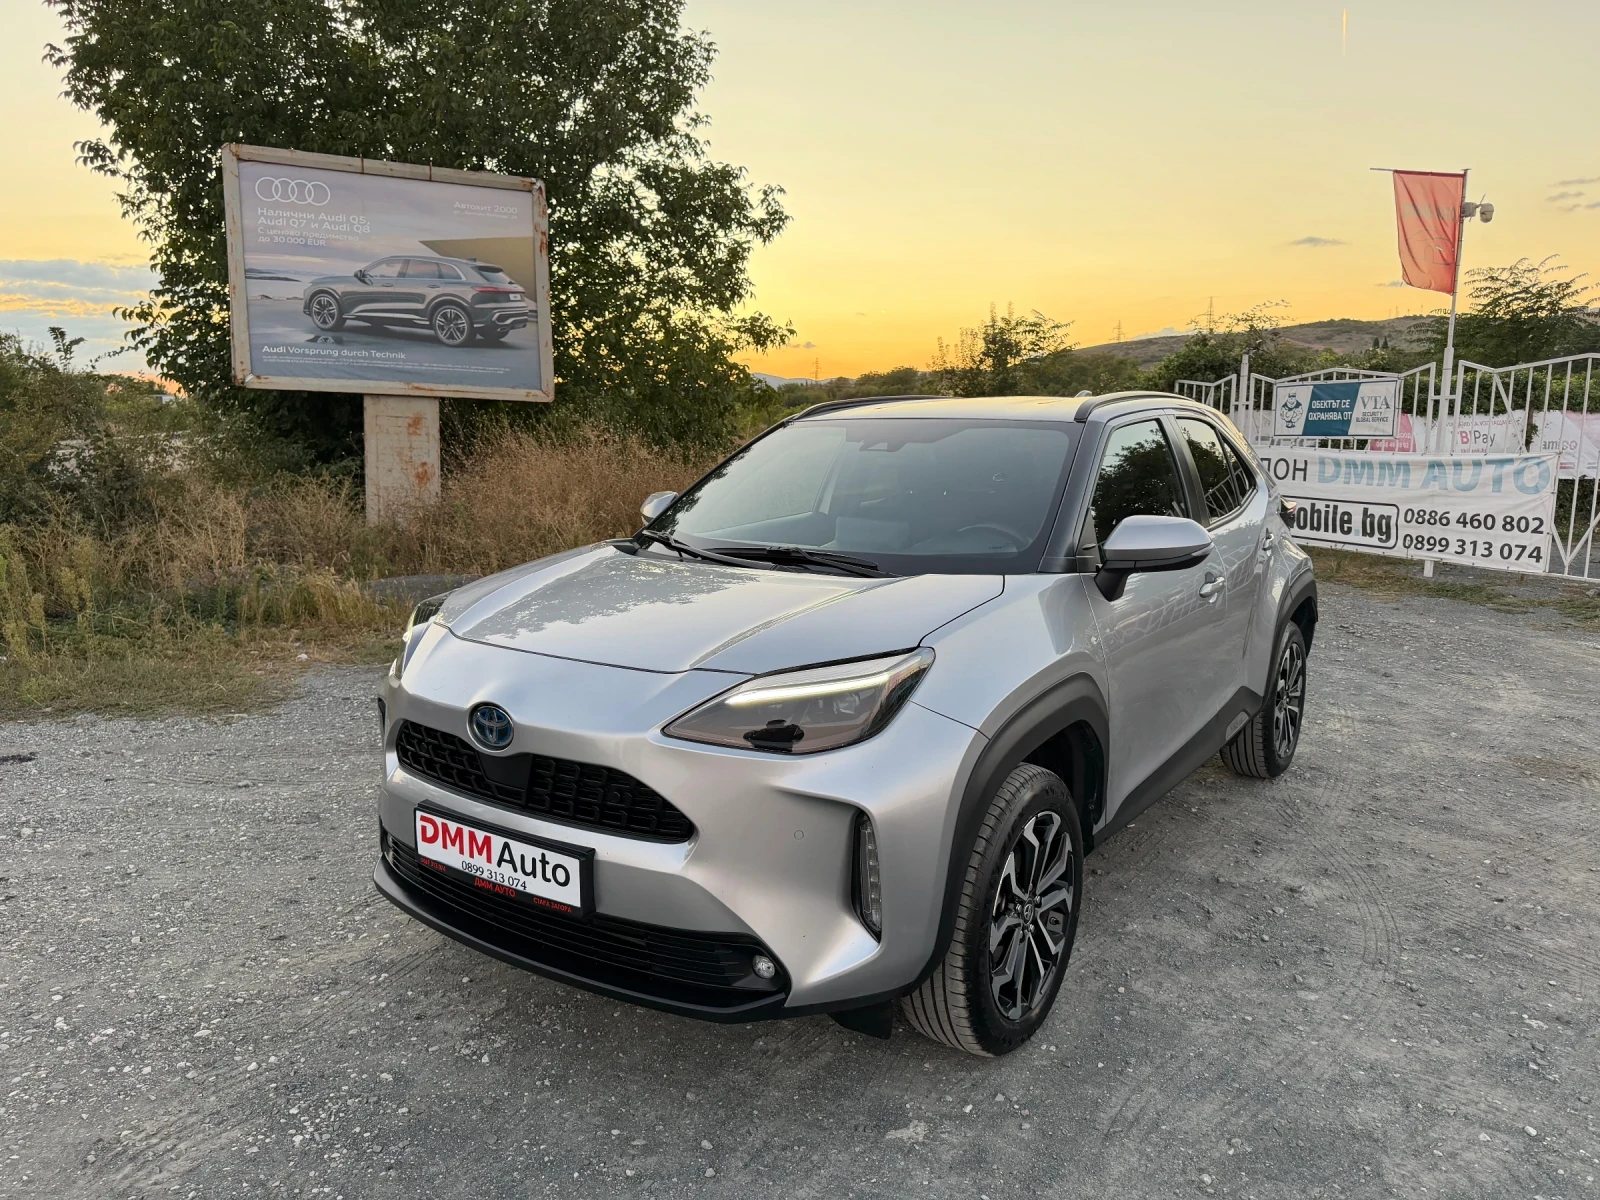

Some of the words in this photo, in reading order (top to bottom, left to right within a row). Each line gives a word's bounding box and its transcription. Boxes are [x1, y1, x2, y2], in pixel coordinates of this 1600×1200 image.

[454, 201, 492, 212] Автохит
[494, 205, 518, 214] 2000
[258, 207, 315, 220] Налични
[318, 212, 346, 222] Audi
[349, 215, 371, 226] Q5,
[257, 217, 287, 226] Audi
[289, 218, 307, 228] Q7
[322, 222, 350, 232] Audi
[353, 224, 371, 234] Q8
[266, 228, 301, 237] ценово
[302, 231, 360, 242] предимство
[273, 236, 285, 244] 30
[286, 236, 305, 245] 000
[307, 238, 326, 247] EUR
[262, 345, 287, 353] Audi
[287, 346, 339, 357] Vorsprung
[341, 348, 369, 358] durch
[370, 350, 406, 359] Technik
[1311, 400, 1340, 409] ОБЕКТЪТ
[1341, 399, 1351, 408] СЕ
[1360, 395, 1391, 410] VTA
[1308, 412, 1342, 420] ОХРАНЯВА
[1343, 411, 1353, 420] ОТ
[1318, 456, 1411, 489] DMM
[1420, 456, 1550, 495] AUTO
[1288, 502, 1392, 543] obile.bg
[1403, 508, 1451, 527] 0886
[1455, 512, 1496, 531] 460
[1501, 515, 1544, 535] 802
[1402, 533, 1450, 553] 0899
[1454, 538, 1494, 558] 313
[1499, 543, 1543, 564] 074
[419, 815, 493, 864] DMM
[496, 841, 571, 887] Auto
[461, 860, 484, 876] 0899
[486, 868, 505, 884] 313
[507, 876, 527, 890] 074
[474, 877, 493, 891] ДММ
[494, 885, 516, 898] АУТО
[533, 897, 550, 907] СТАРА
[551, 902, 572, 913] ЗАГОРА
